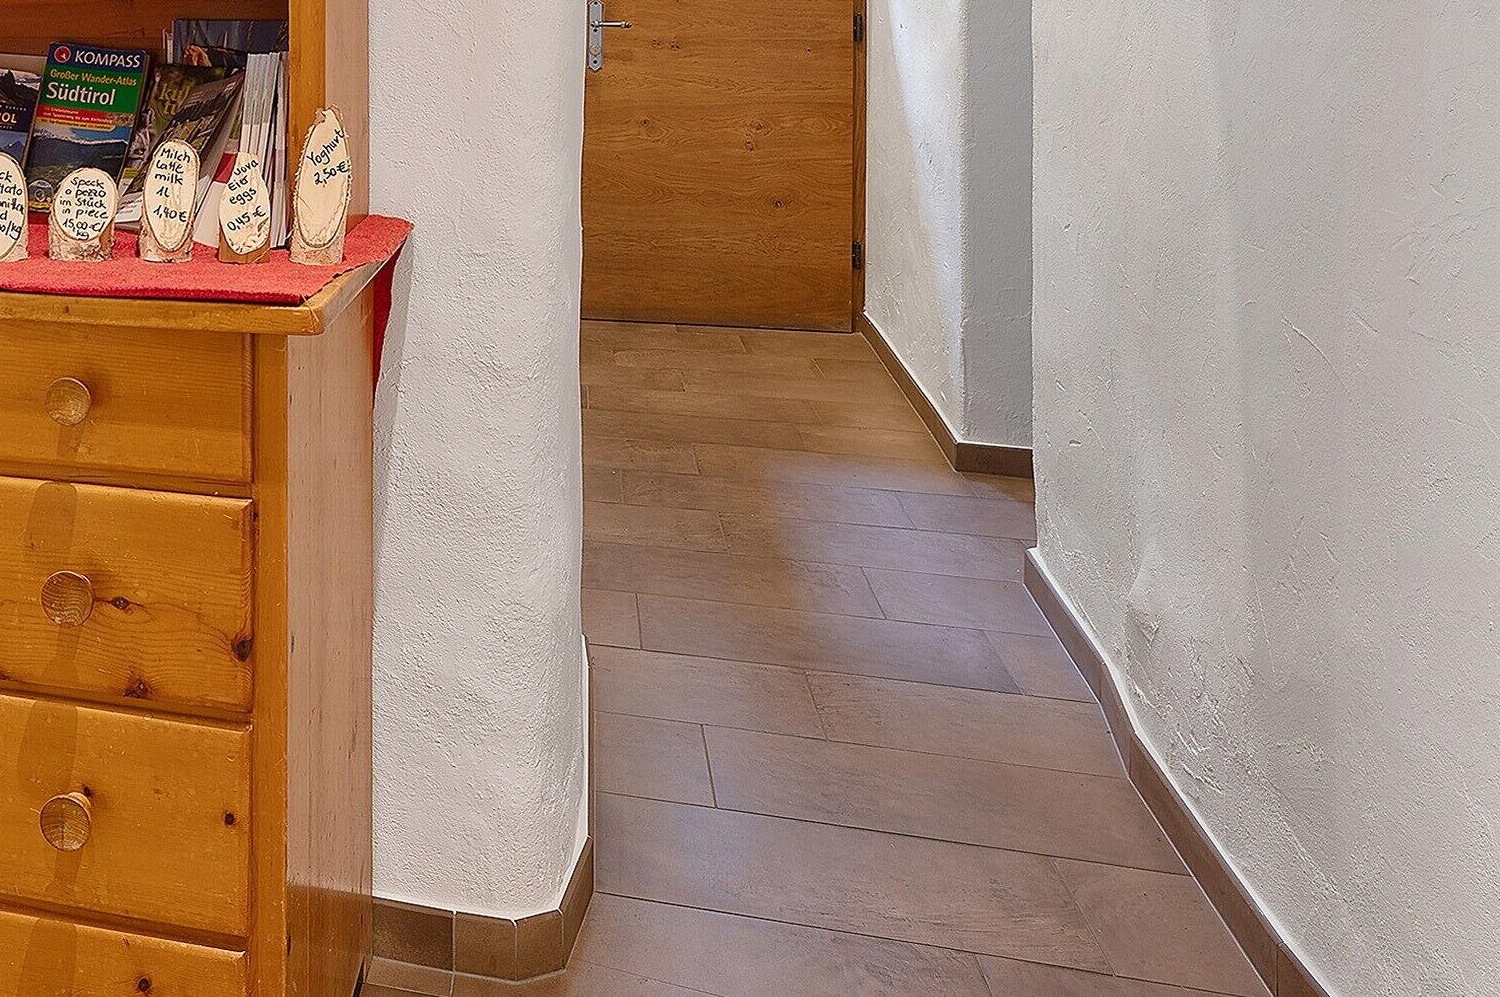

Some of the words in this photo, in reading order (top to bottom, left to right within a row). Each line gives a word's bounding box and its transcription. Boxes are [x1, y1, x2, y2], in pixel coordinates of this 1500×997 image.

[75, 50, 141, 68] KOMPASS
[50, 68, 79, 81] Großer
[81, 72, 137, 86] Wander-Atlas
[46, 82, 116, 105] Südtirol
[160, 148, 191, 163] Milch
[306, 129, 345, 166] Yoghurt
[70, 177, 104, 189] Speck
[154, 173, 184, 186] milk
[60, 196, 71, 206] im
[229, 187, 257, 205] eggs
[75, 209, 108, 219] piece
